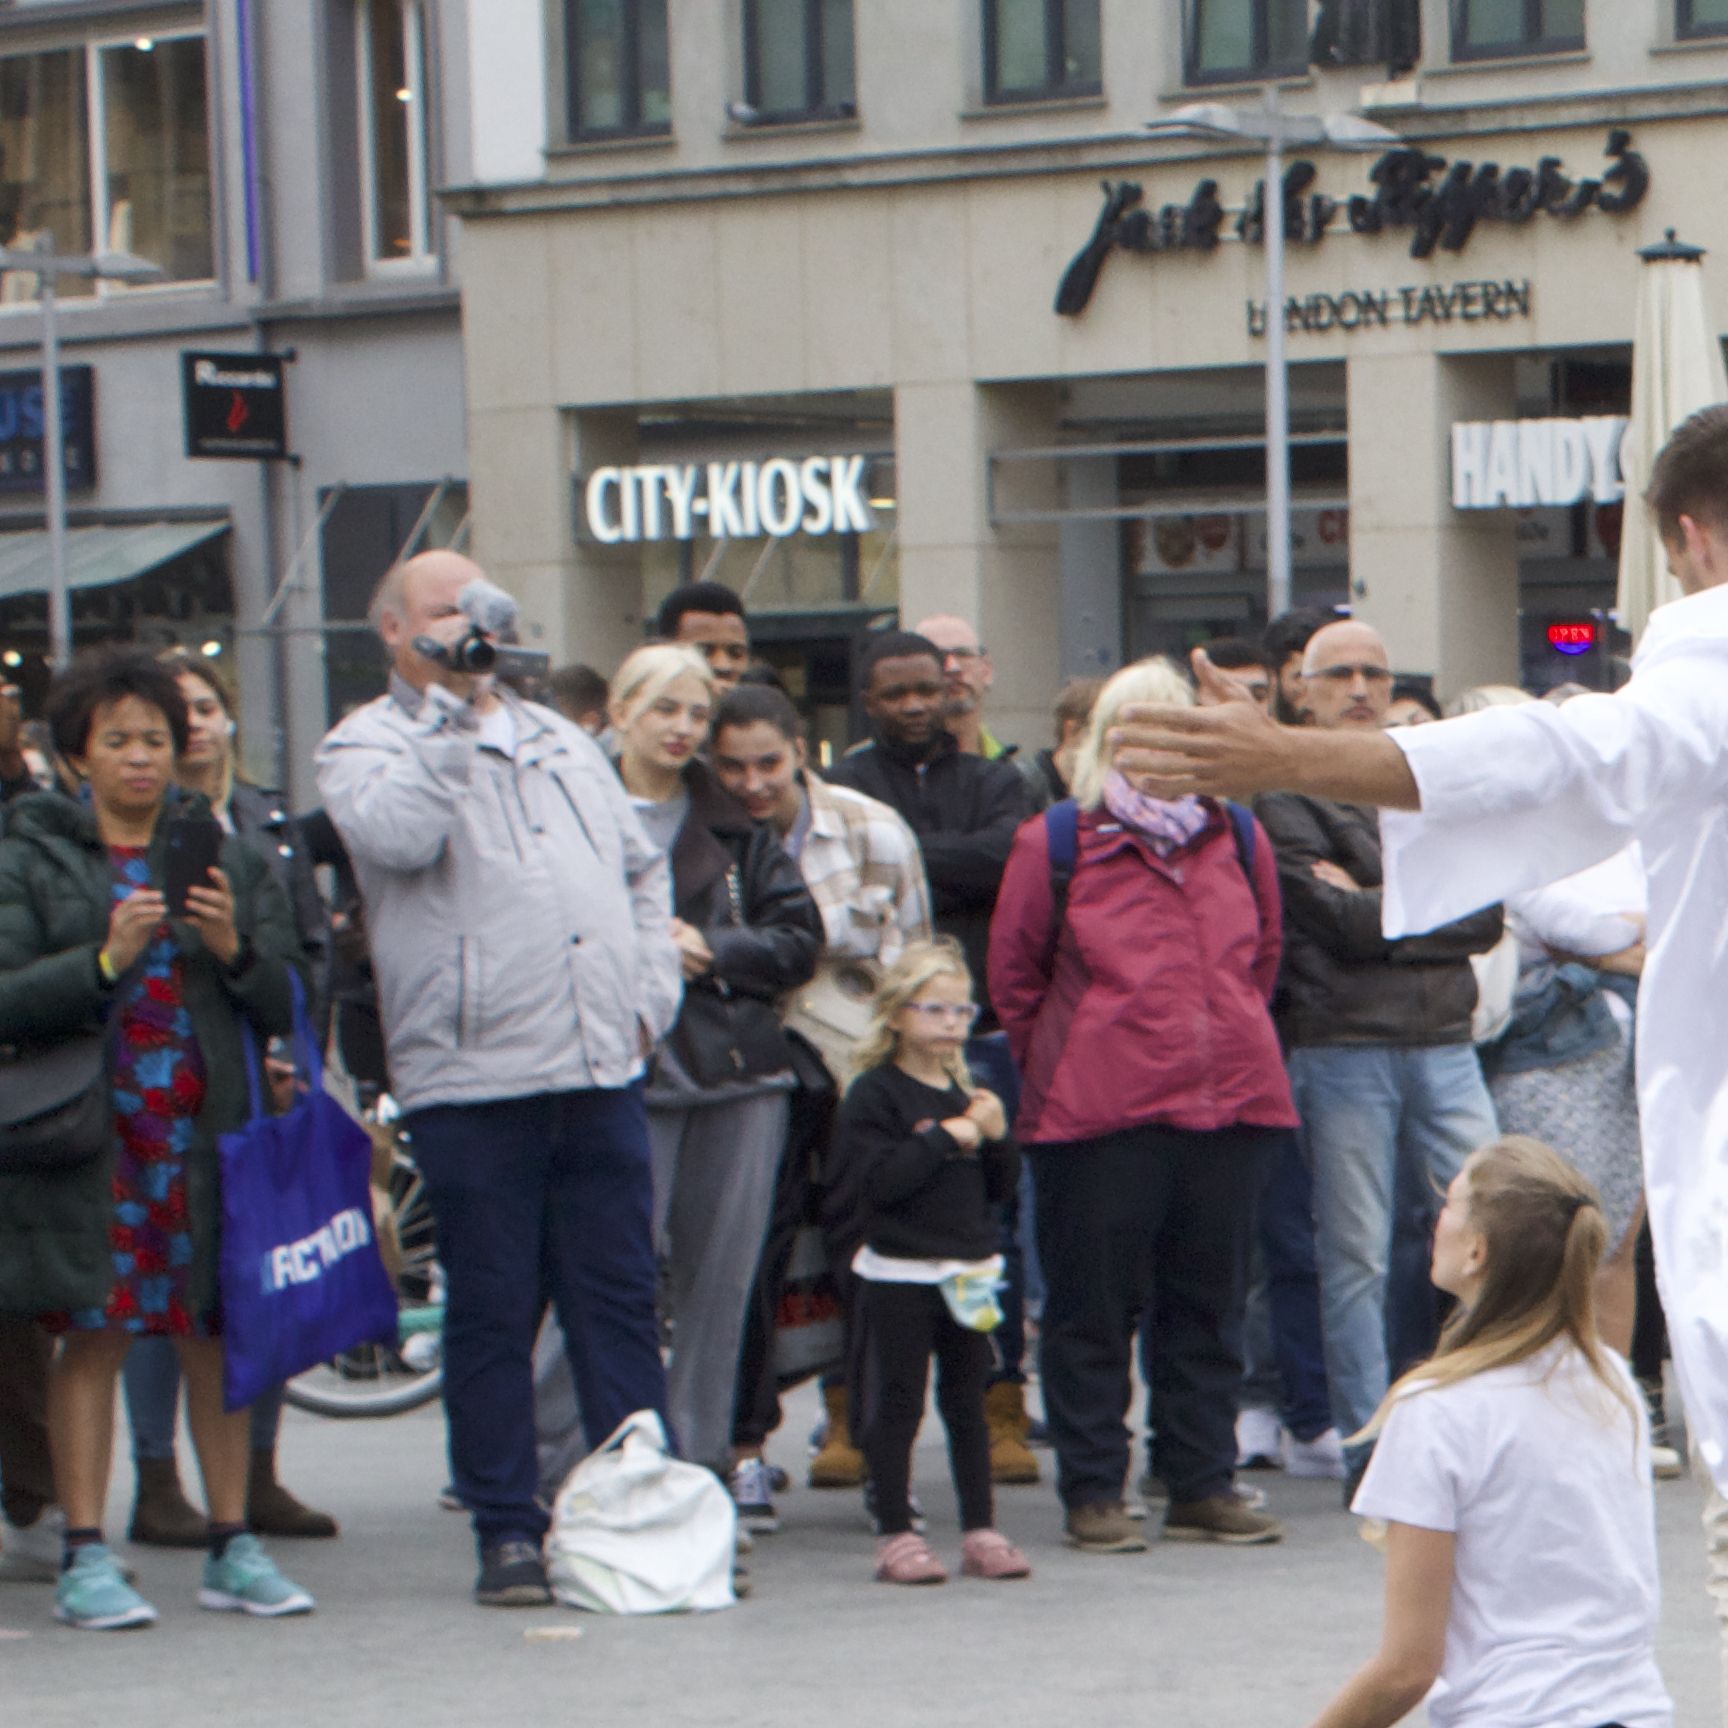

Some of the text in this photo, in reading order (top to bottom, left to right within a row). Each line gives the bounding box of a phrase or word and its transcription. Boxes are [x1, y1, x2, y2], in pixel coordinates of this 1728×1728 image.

[1246, 279, 1533, 337] LNDON TAVERN
[585, 453, 871, 545] CITY-KIOSK
[1451, 415, 1629, 508] HANDY
